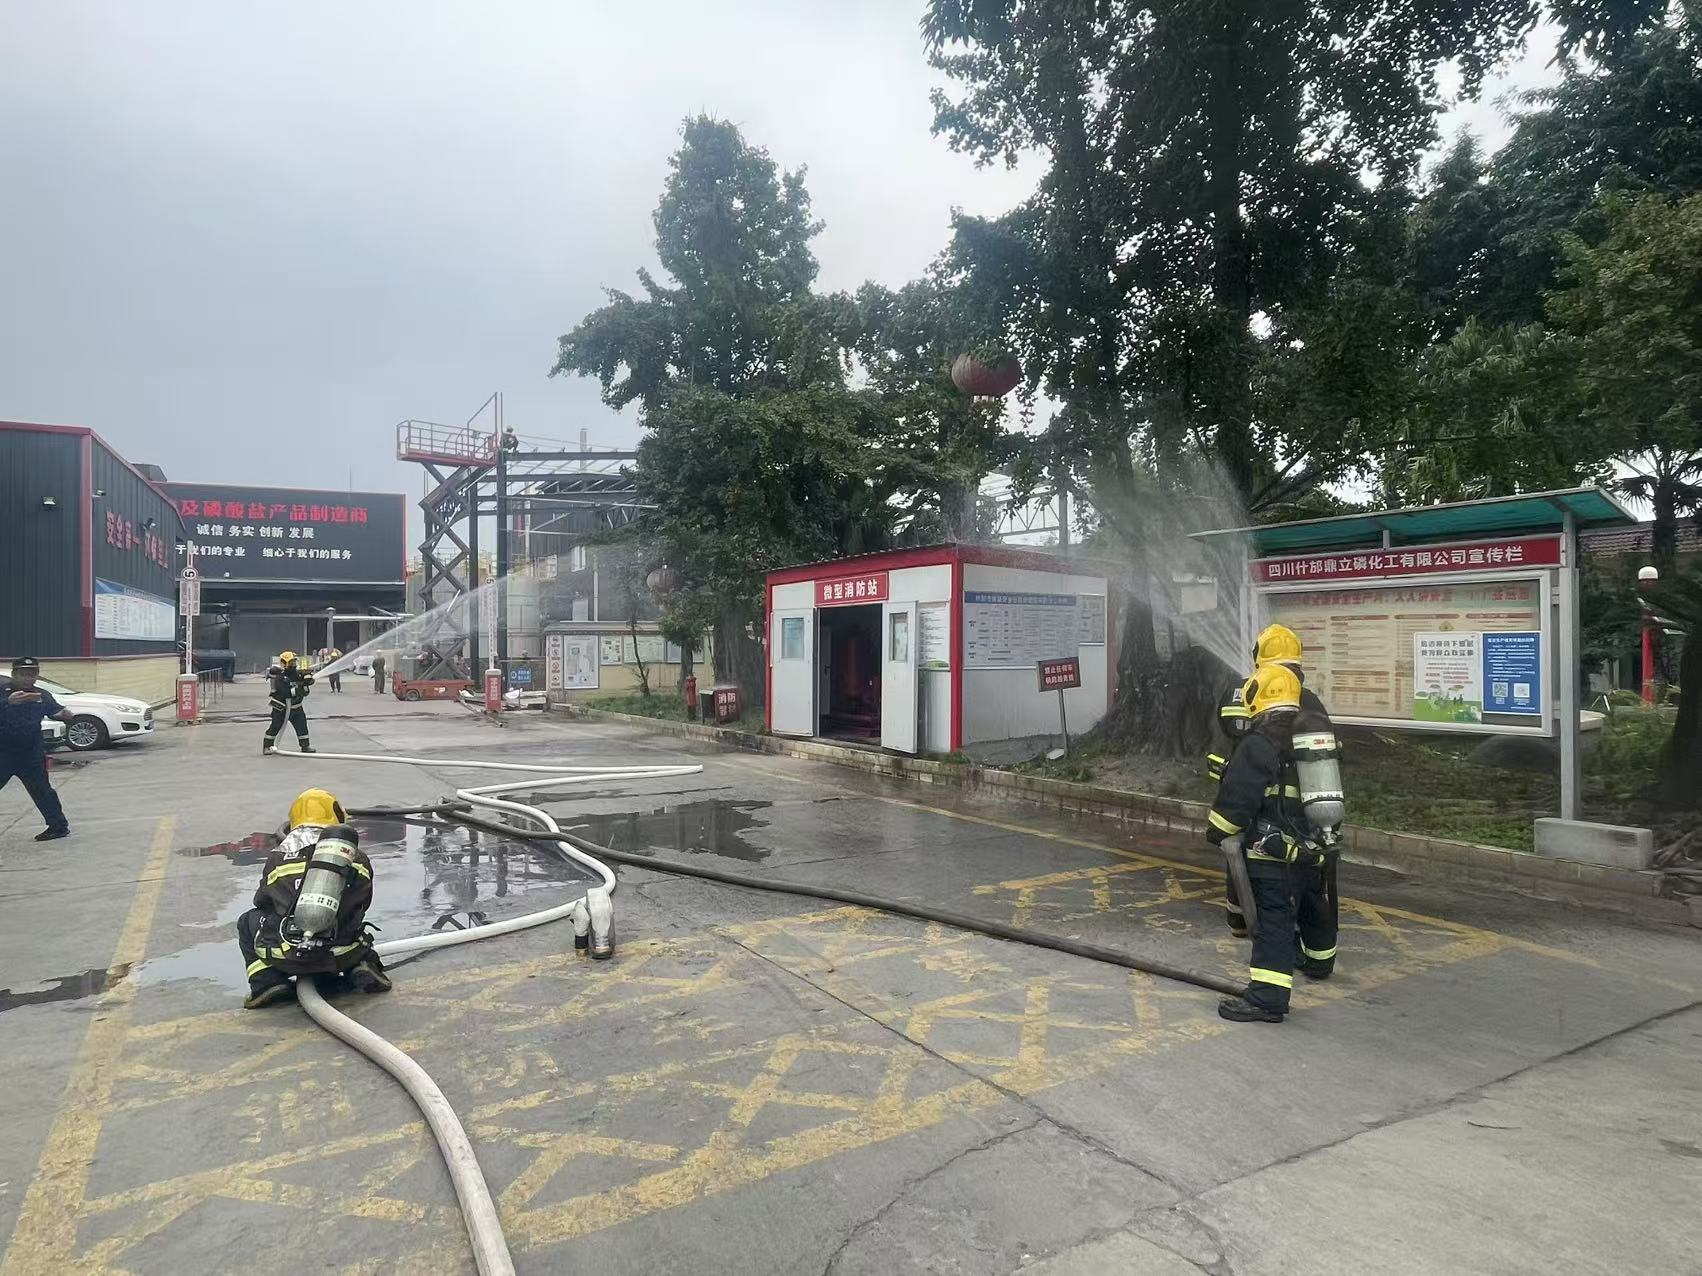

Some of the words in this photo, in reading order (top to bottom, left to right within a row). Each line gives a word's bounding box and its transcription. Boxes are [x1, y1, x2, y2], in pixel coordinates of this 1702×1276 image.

[196, 524, 223, 536] 诚信
[229, 525, 255, 537] 务实
[259, 526, 284, 538] 创新
[289, 527, 315, 538] 发展
[262, 547, 352, 560] 细心于我们的服务
[1268, 546, 1523, 577] 四川什邡鼎立磷化工有限公司宣传栏
[823, 579, 878, 600] 微型消防站
[718, 692, 736, 705] 消防
